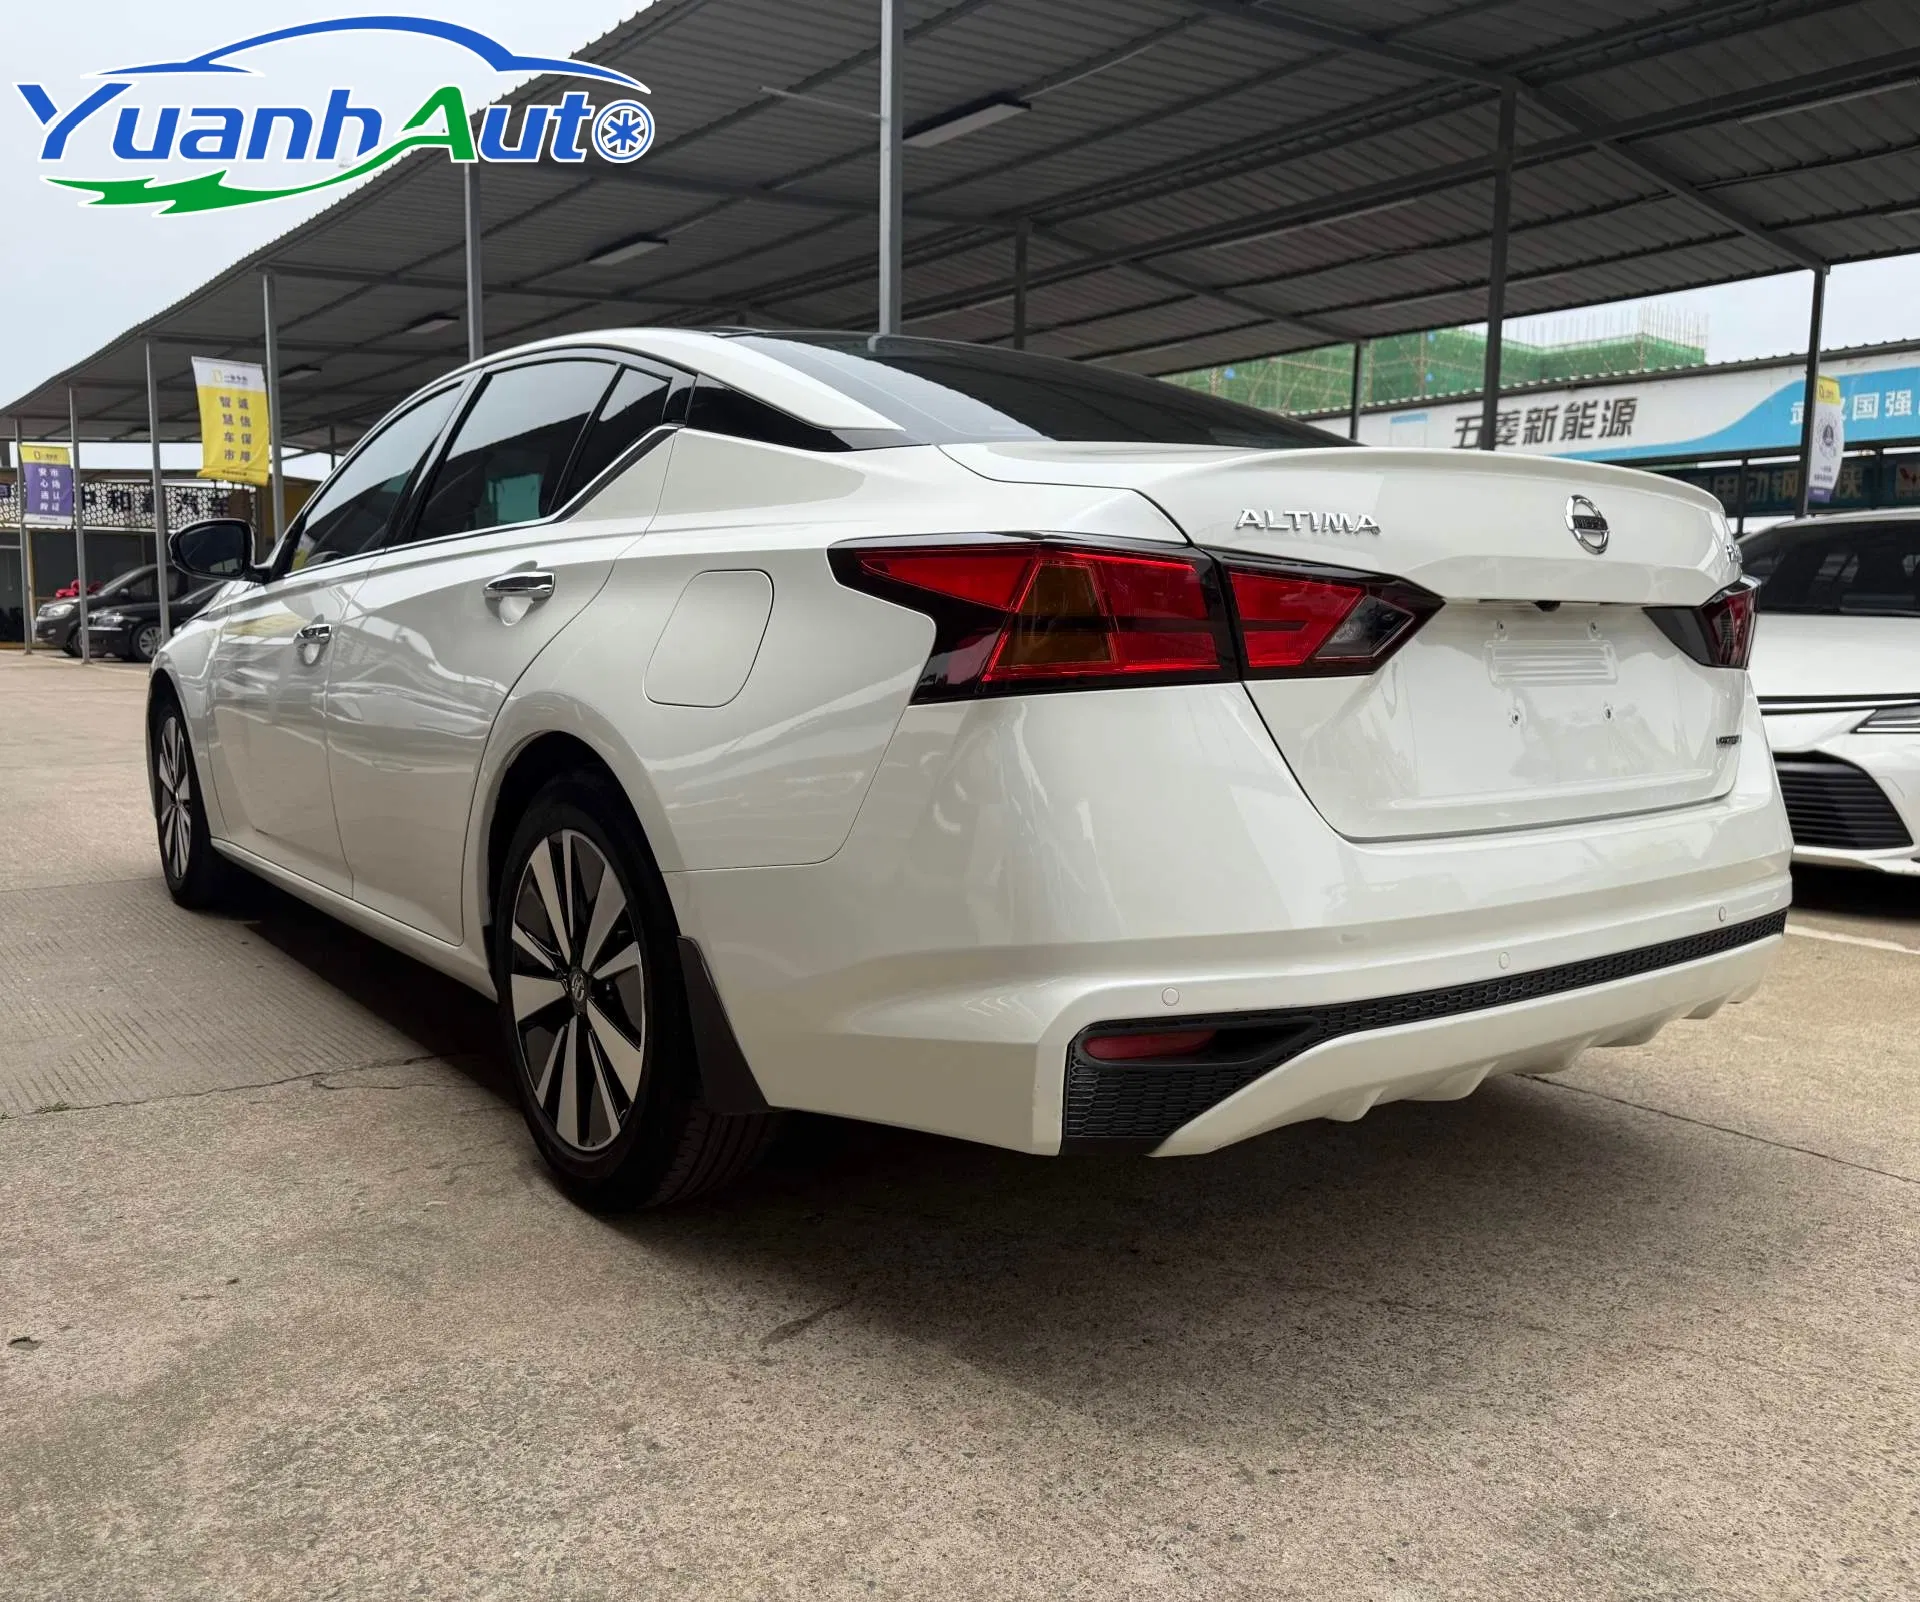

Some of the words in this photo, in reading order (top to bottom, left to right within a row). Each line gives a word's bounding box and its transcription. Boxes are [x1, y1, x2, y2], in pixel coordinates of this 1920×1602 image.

[1453, 397, 1638, 449] 五菱新能源
[1234, 508, 1381, 535] ALTIMA
